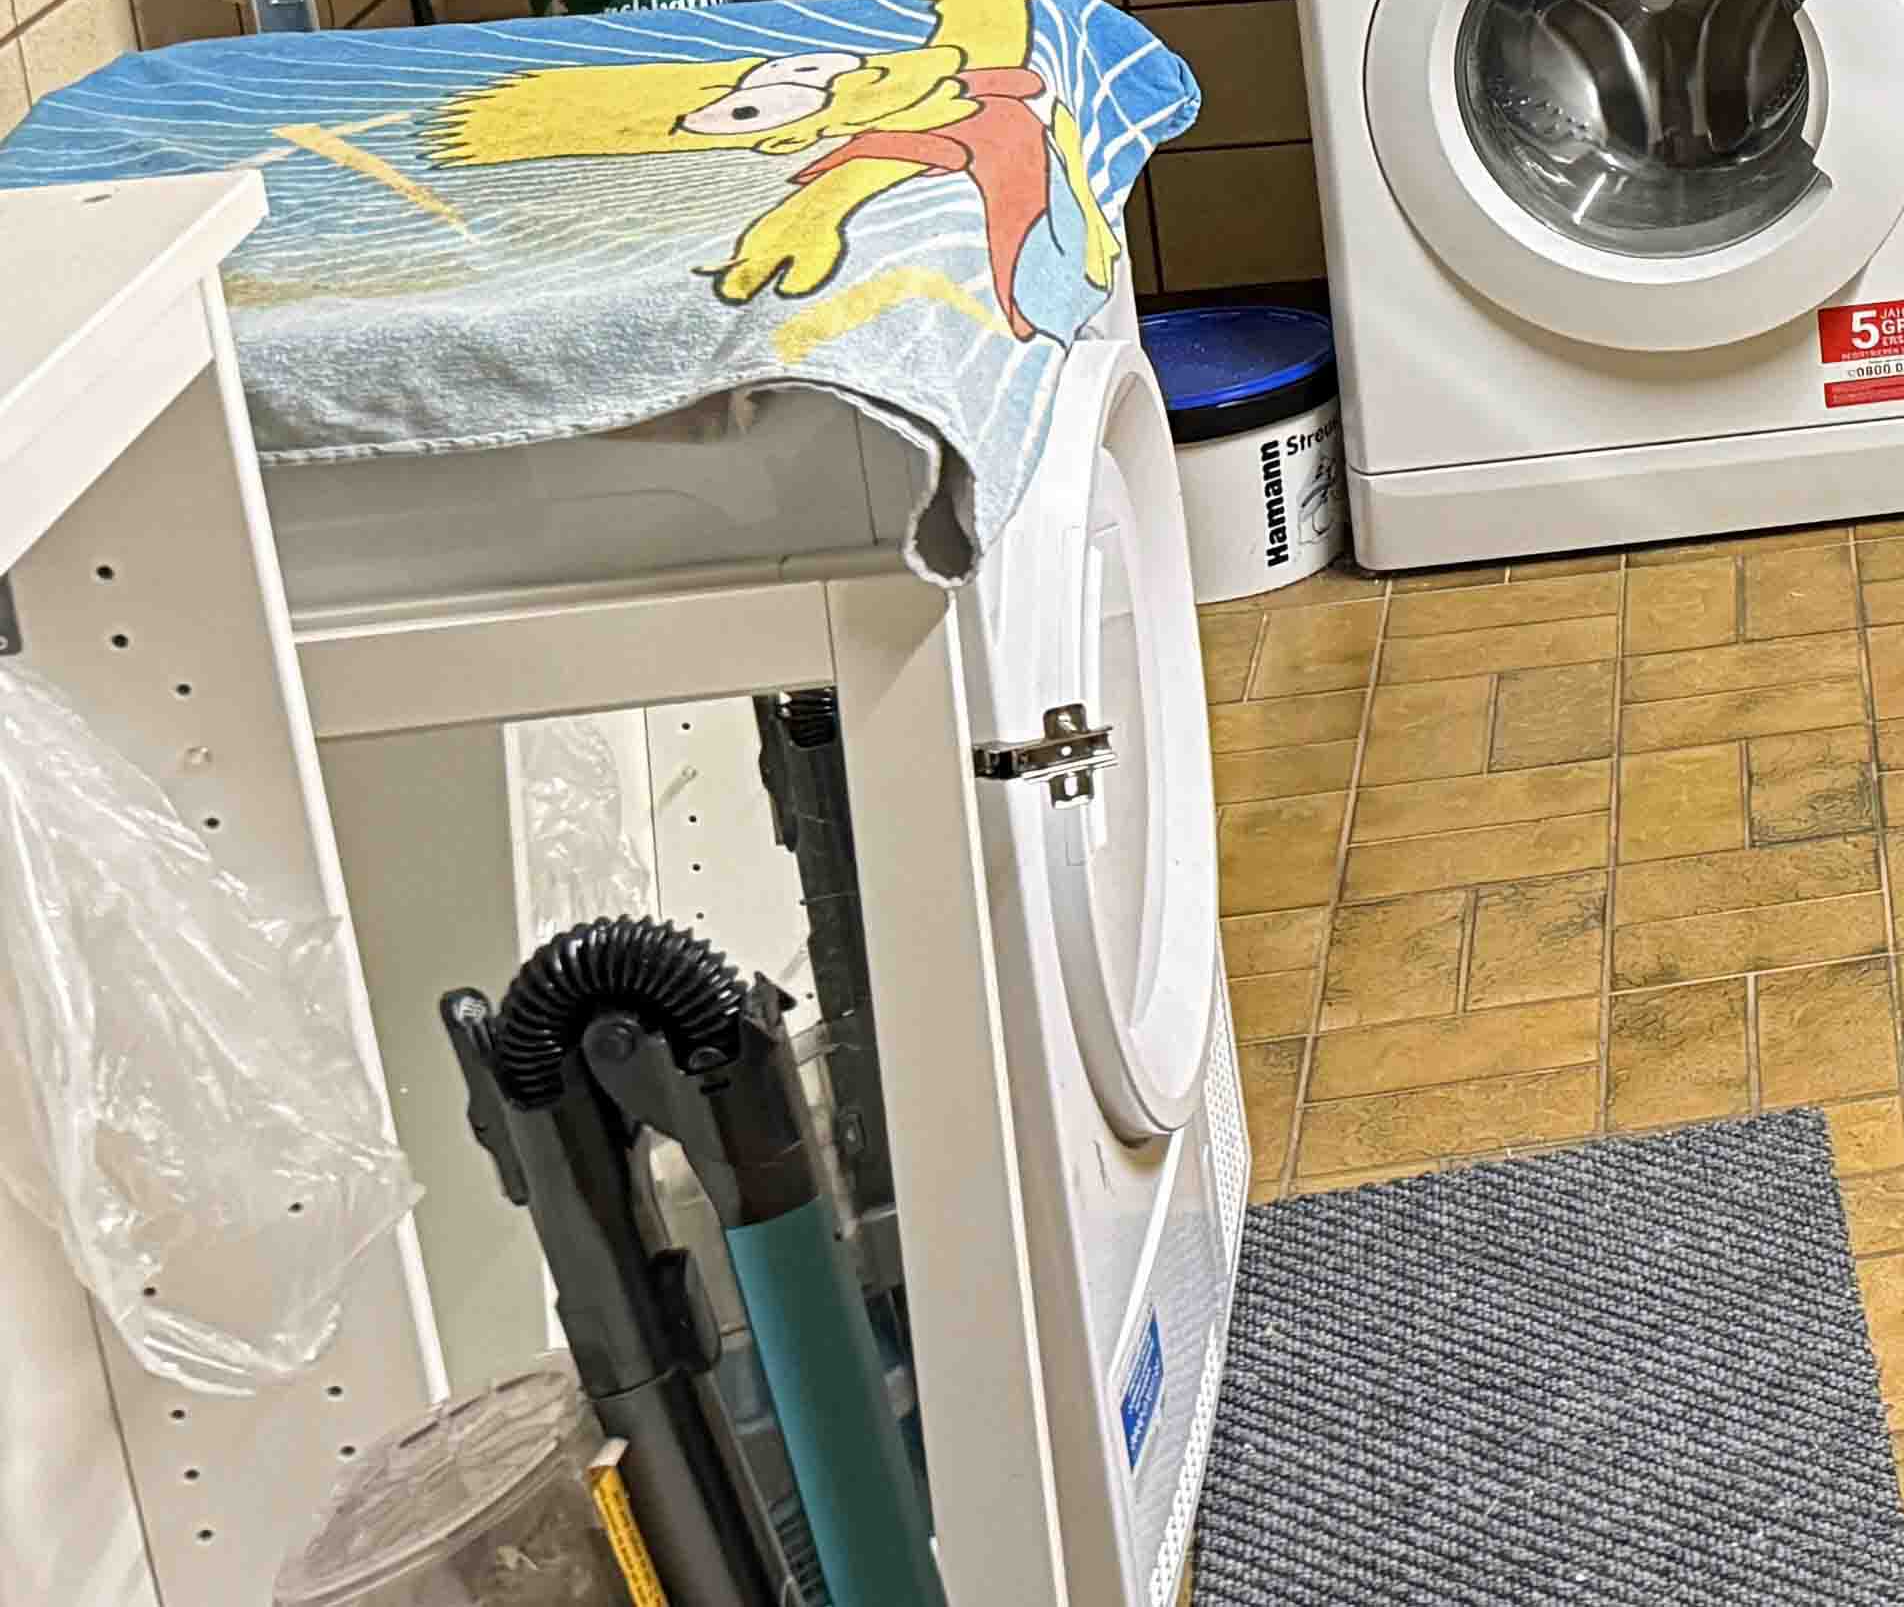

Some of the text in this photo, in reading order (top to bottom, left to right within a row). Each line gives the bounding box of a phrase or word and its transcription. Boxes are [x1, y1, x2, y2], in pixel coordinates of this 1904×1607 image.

[1850, 309, 1881, 350] 5
[1856, 363, 1891, 378] 0800
[1260, 439, 1290, 568] Hamann
